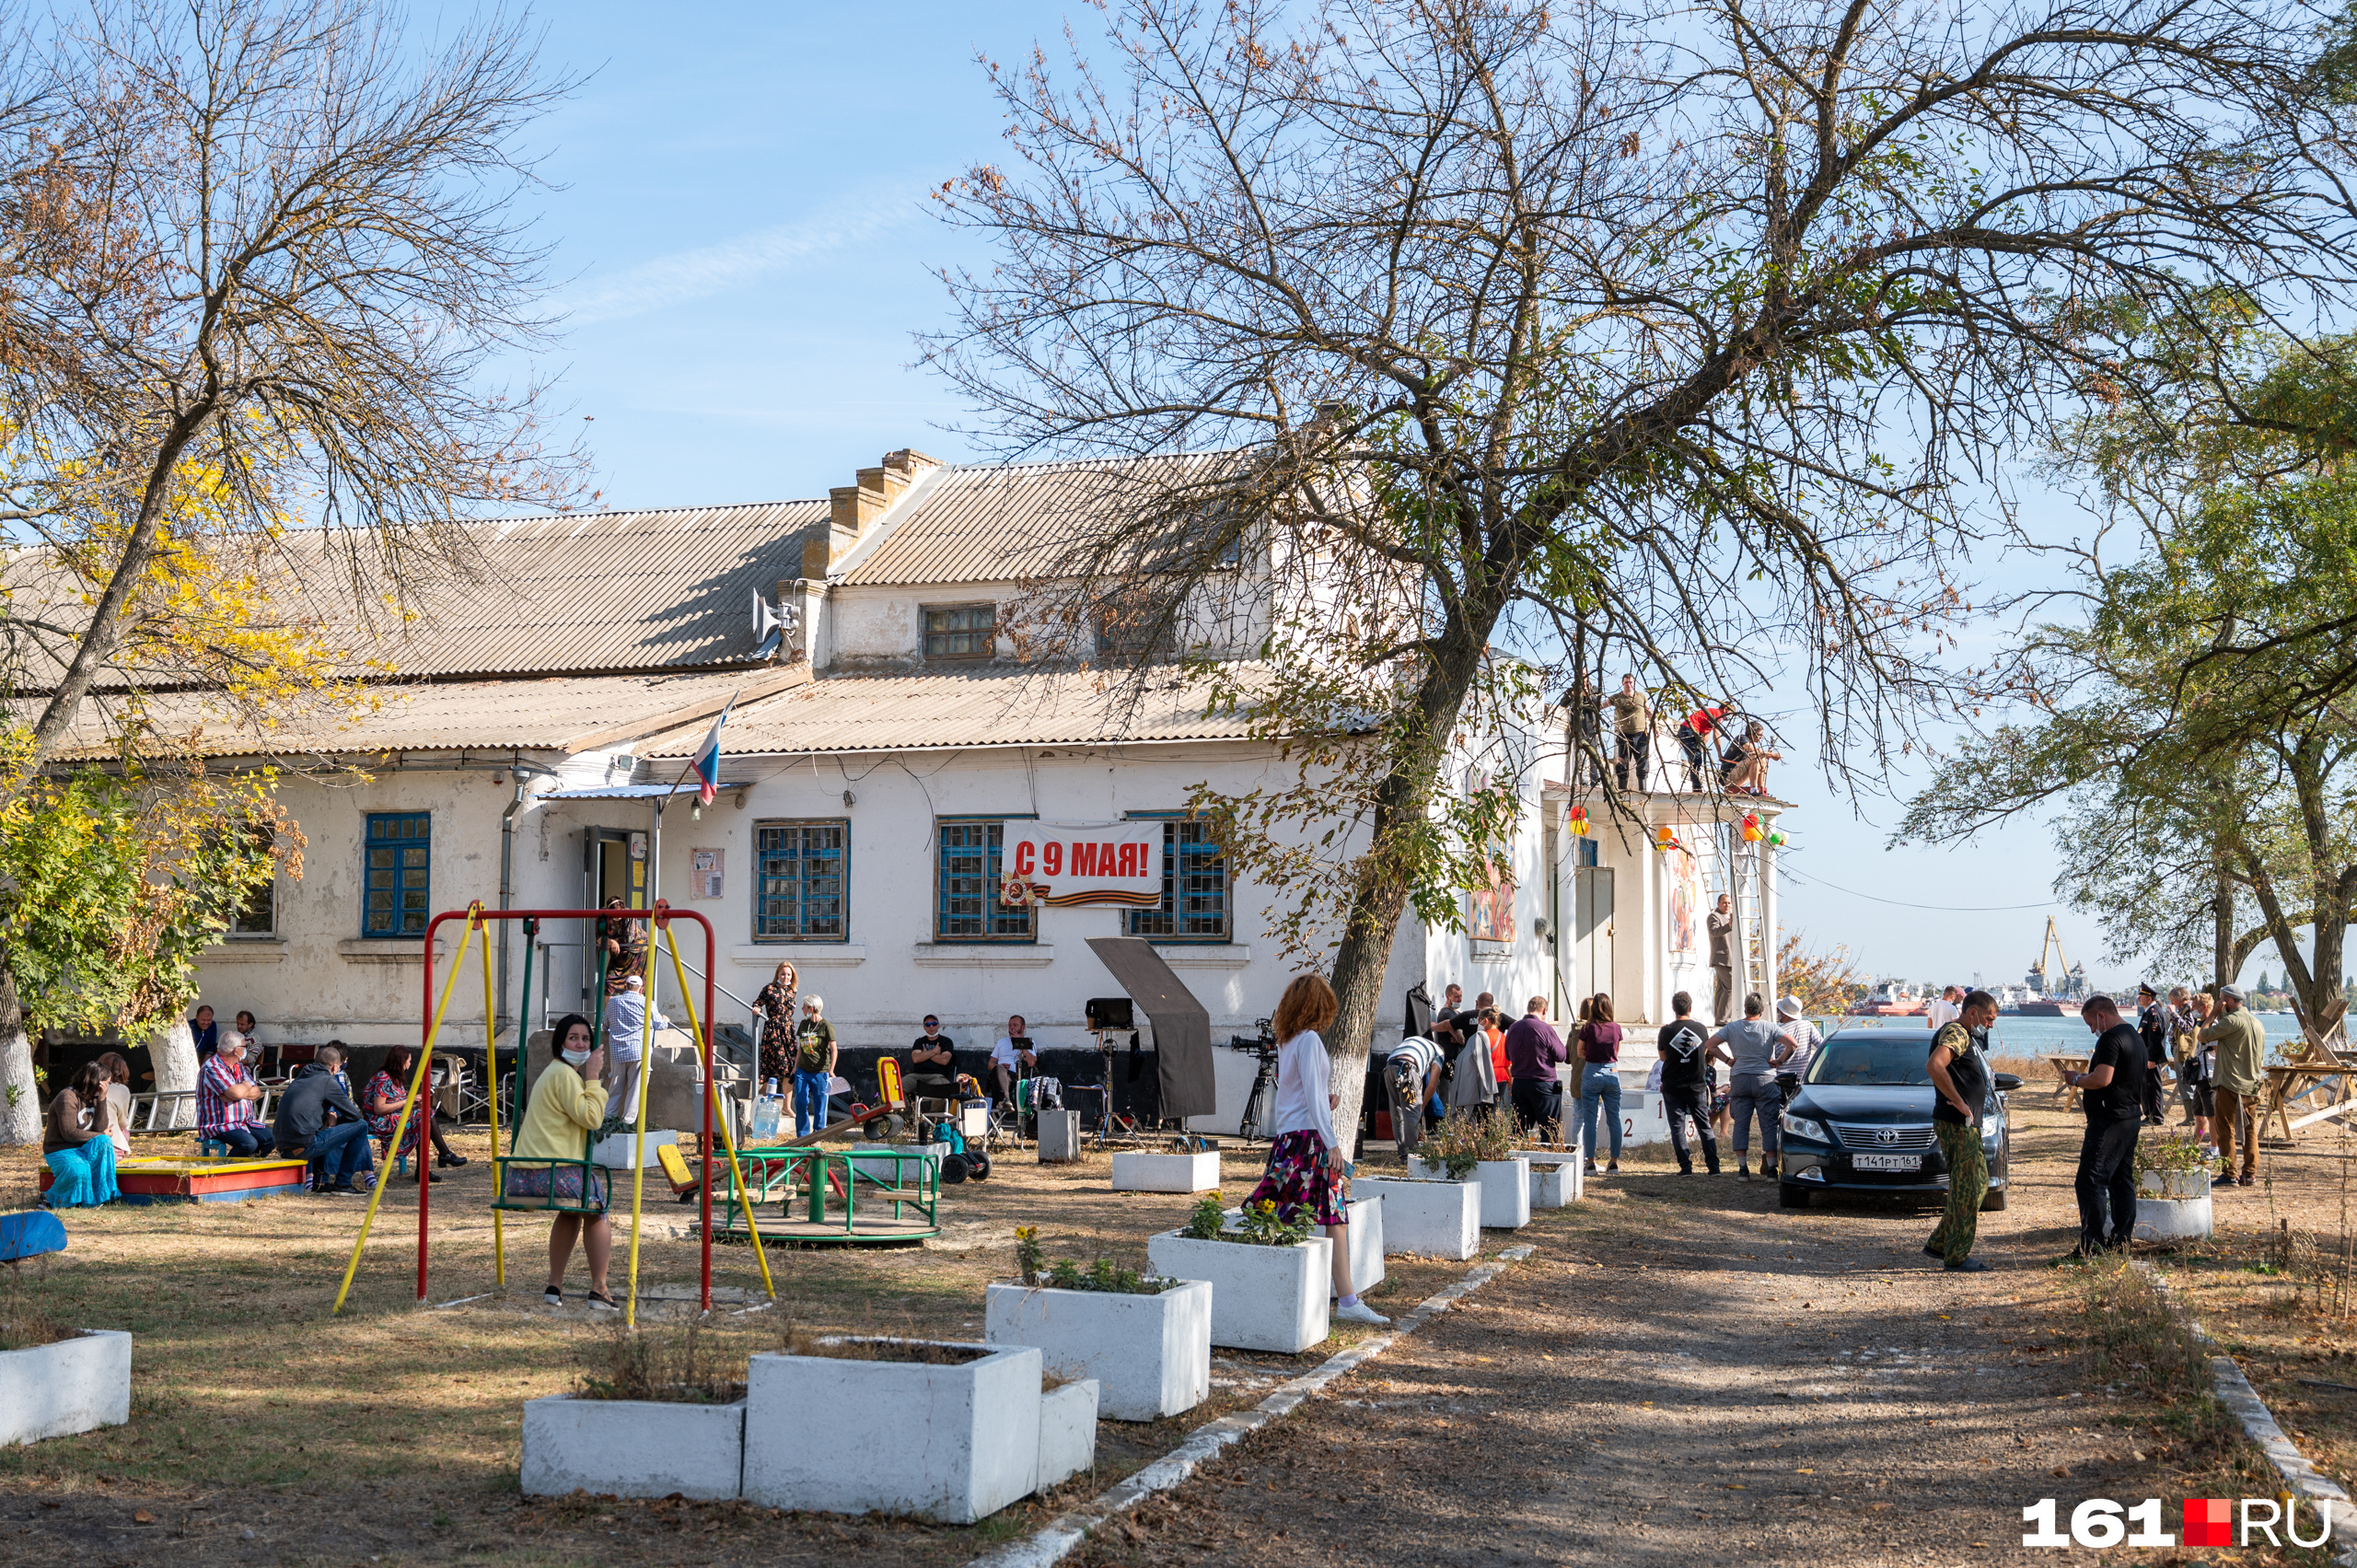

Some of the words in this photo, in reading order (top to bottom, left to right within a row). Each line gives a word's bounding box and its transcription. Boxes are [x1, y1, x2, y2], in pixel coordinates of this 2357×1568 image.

[1016, 841, 1035, 876] С
[1042, 842, 1062, 877] 9
[1071, 842, 1149, 877] МАЯ!
[1657, 1099, 1663, 1119] 1
[1623, 1118, 1632, 1137] 2
[1686, 1121, 1694, 1137] 3
[1901, 1156, 1918, 1165] 161
